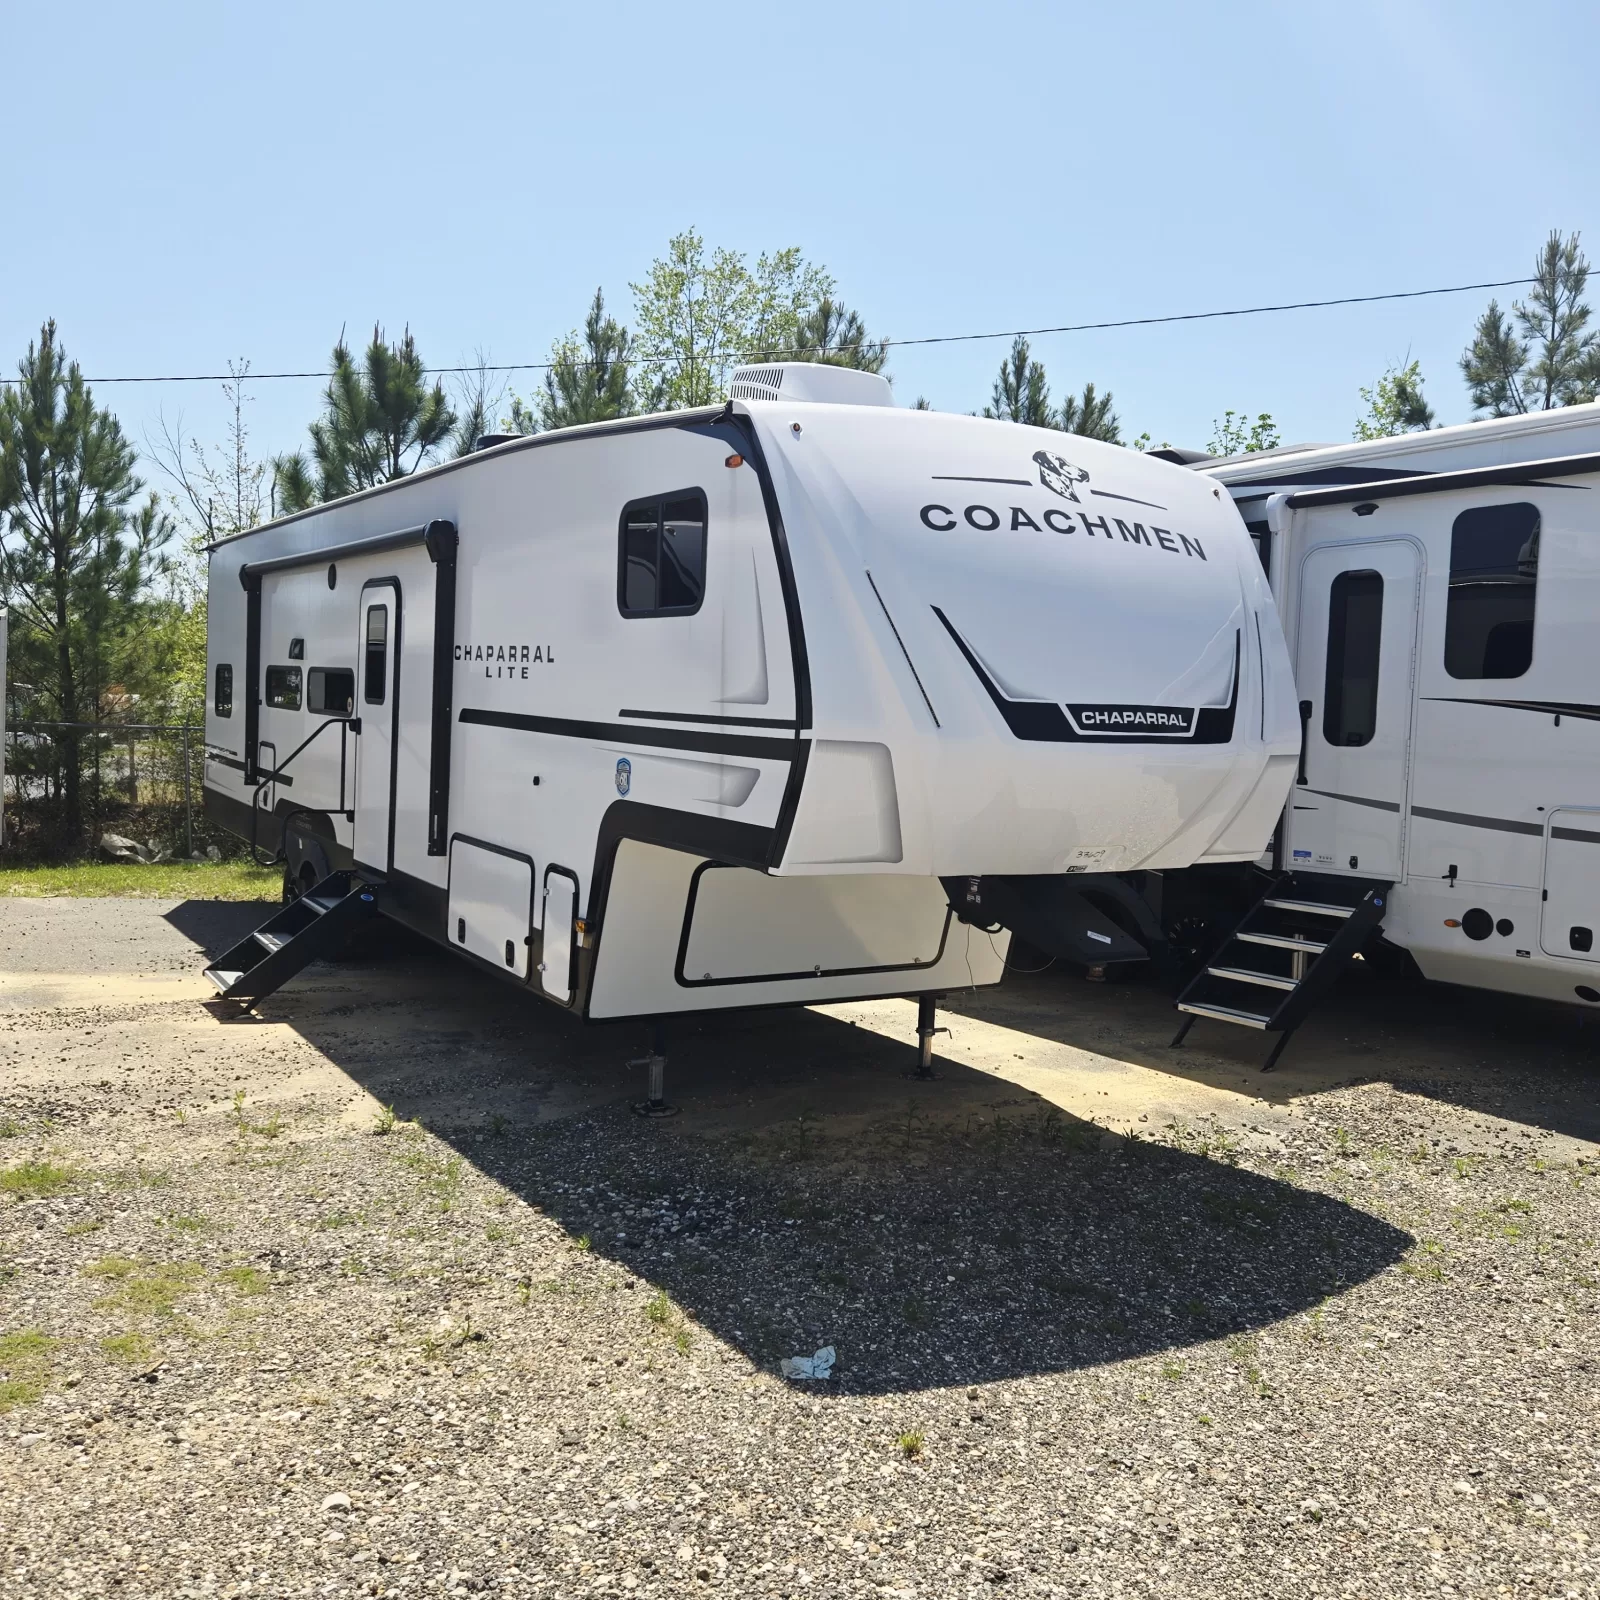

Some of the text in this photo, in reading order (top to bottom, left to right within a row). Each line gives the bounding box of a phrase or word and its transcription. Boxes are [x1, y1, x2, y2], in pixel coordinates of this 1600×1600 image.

[919, 504, 1208, 562] COACHMEN
[454, 645, 555, 663] CHAPARRAL
[485, 666, 529, 679] LITE
[1081, 711, 1188, 727] CHAPARRAL
